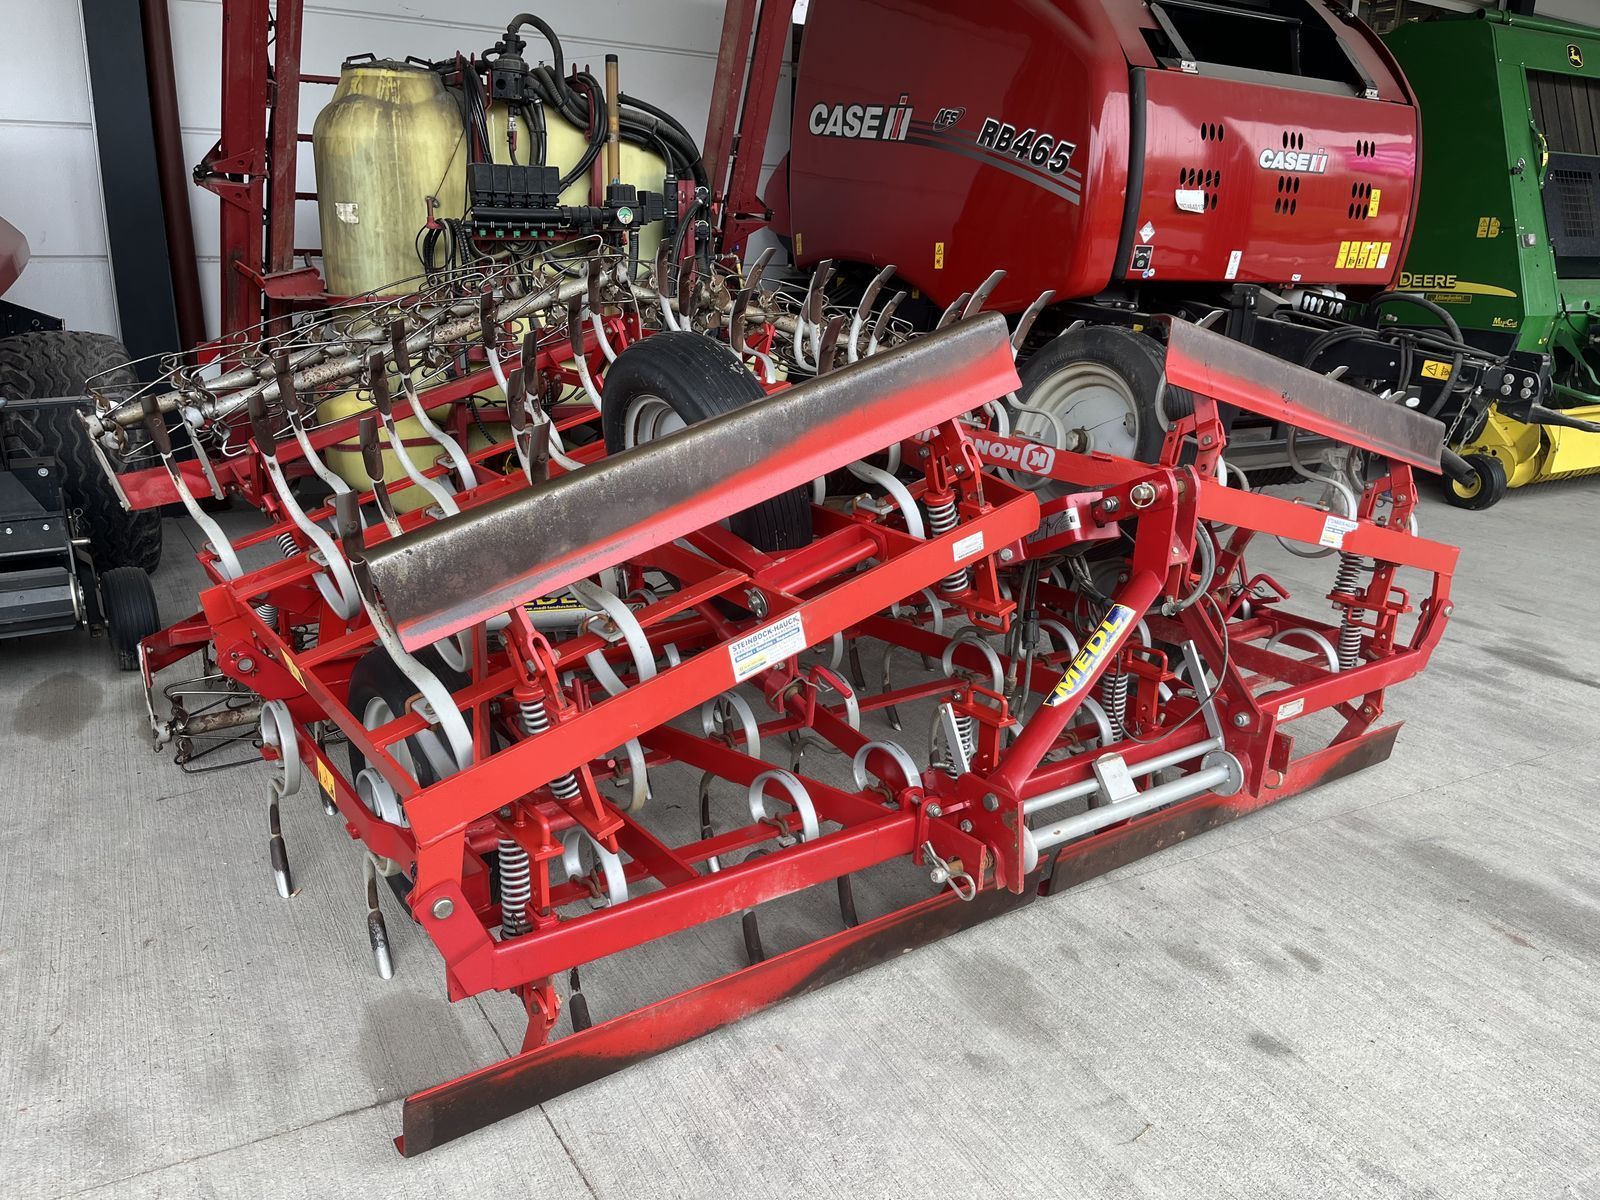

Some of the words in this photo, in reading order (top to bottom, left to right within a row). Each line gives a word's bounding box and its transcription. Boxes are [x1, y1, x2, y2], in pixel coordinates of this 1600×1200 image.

[977, 117, 1077, 176] RB465
[1399, 272, 1457, 290] DEERE
[1054, 617, 1121, 697] MEDL
